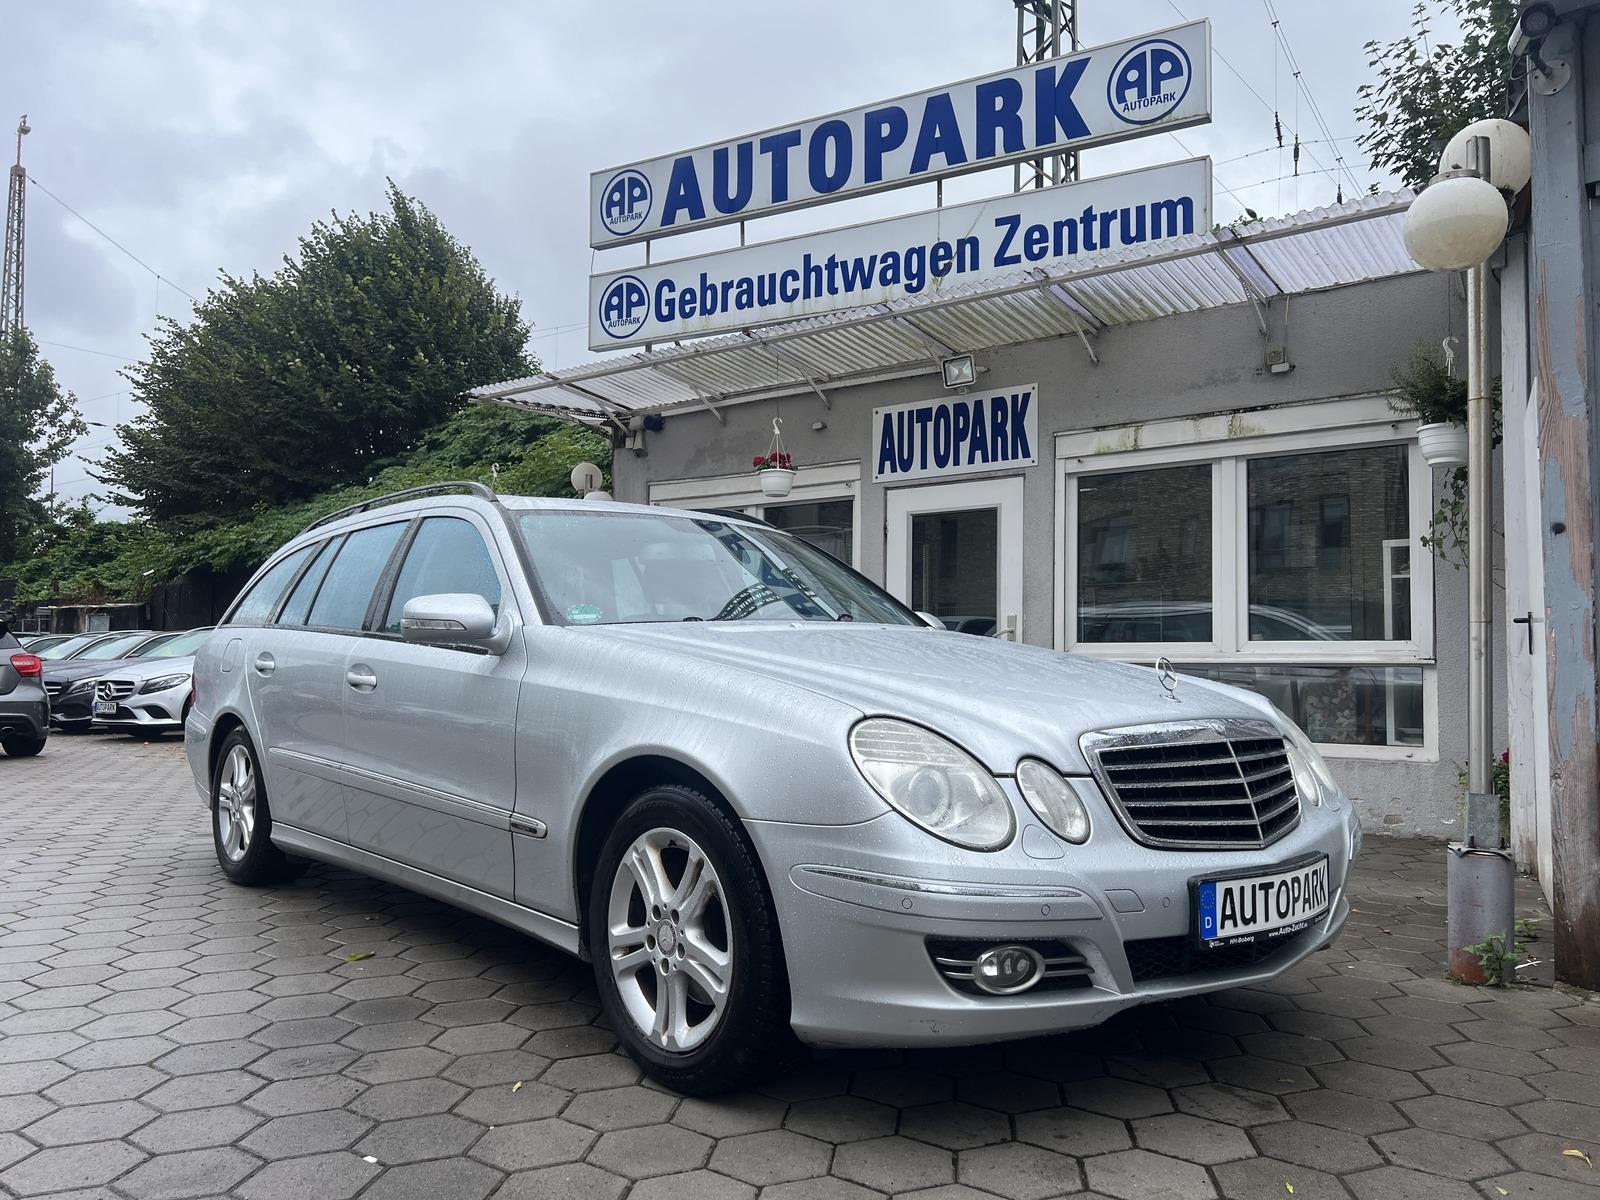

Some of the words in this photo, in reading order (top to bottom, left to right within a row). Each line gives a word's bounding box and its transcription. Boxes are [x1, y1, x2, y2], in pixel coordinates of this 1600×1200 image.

[1116, 48, 1184, 104] AP
[1123, 91, 1176, 112] AUTOPARK
[660, 57, 1092, 227] AUTOPARK
[605, 177, 648, 219] AP
[609, 211, 643, 225] AUTOPARK
[653, 235, 981, 324] Gebrauchtwagen
[993, 195, 1194, 268] Zentrum
[604, 282, 646, 322] AP
[608, 316, 641, 329] AUTOPARK
[877, 391, 1032, 475] AUTOPARK
[1204, 916, 1212, 929] D
[1220, 864, 1327, 930] AUTOPARK
